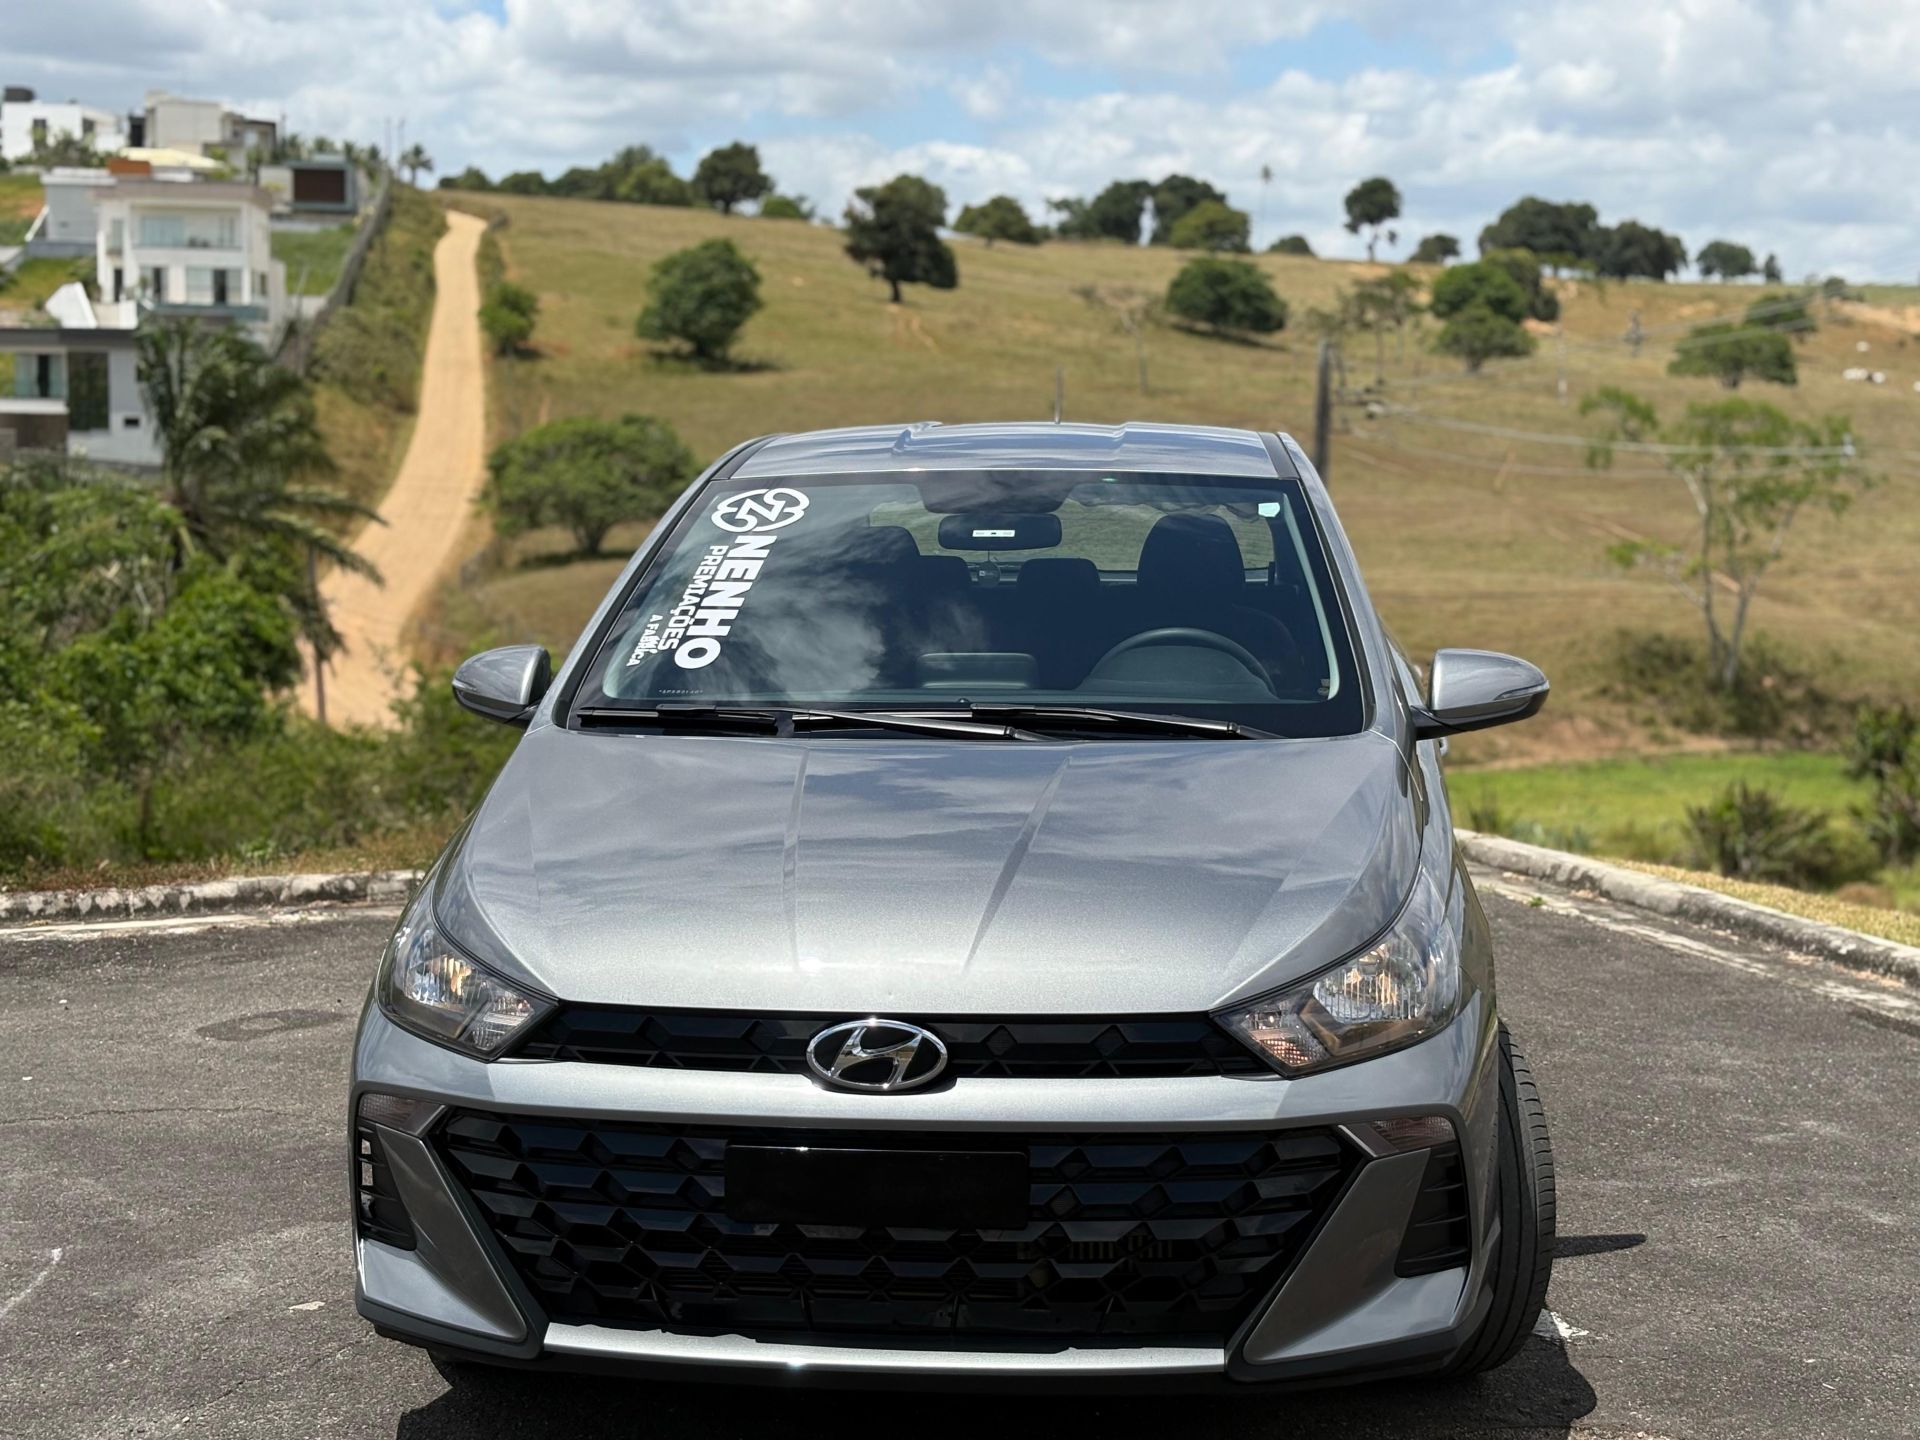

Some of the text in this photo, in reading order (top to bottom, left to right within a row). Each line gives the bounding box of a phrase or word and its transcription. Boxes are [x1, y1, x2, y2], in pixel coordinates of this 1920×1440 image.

[649, 614, 664, 622] A
[657, 545, 730, 651] PREMIAÇÕES
[674, 535, 778, 670] NENHO
